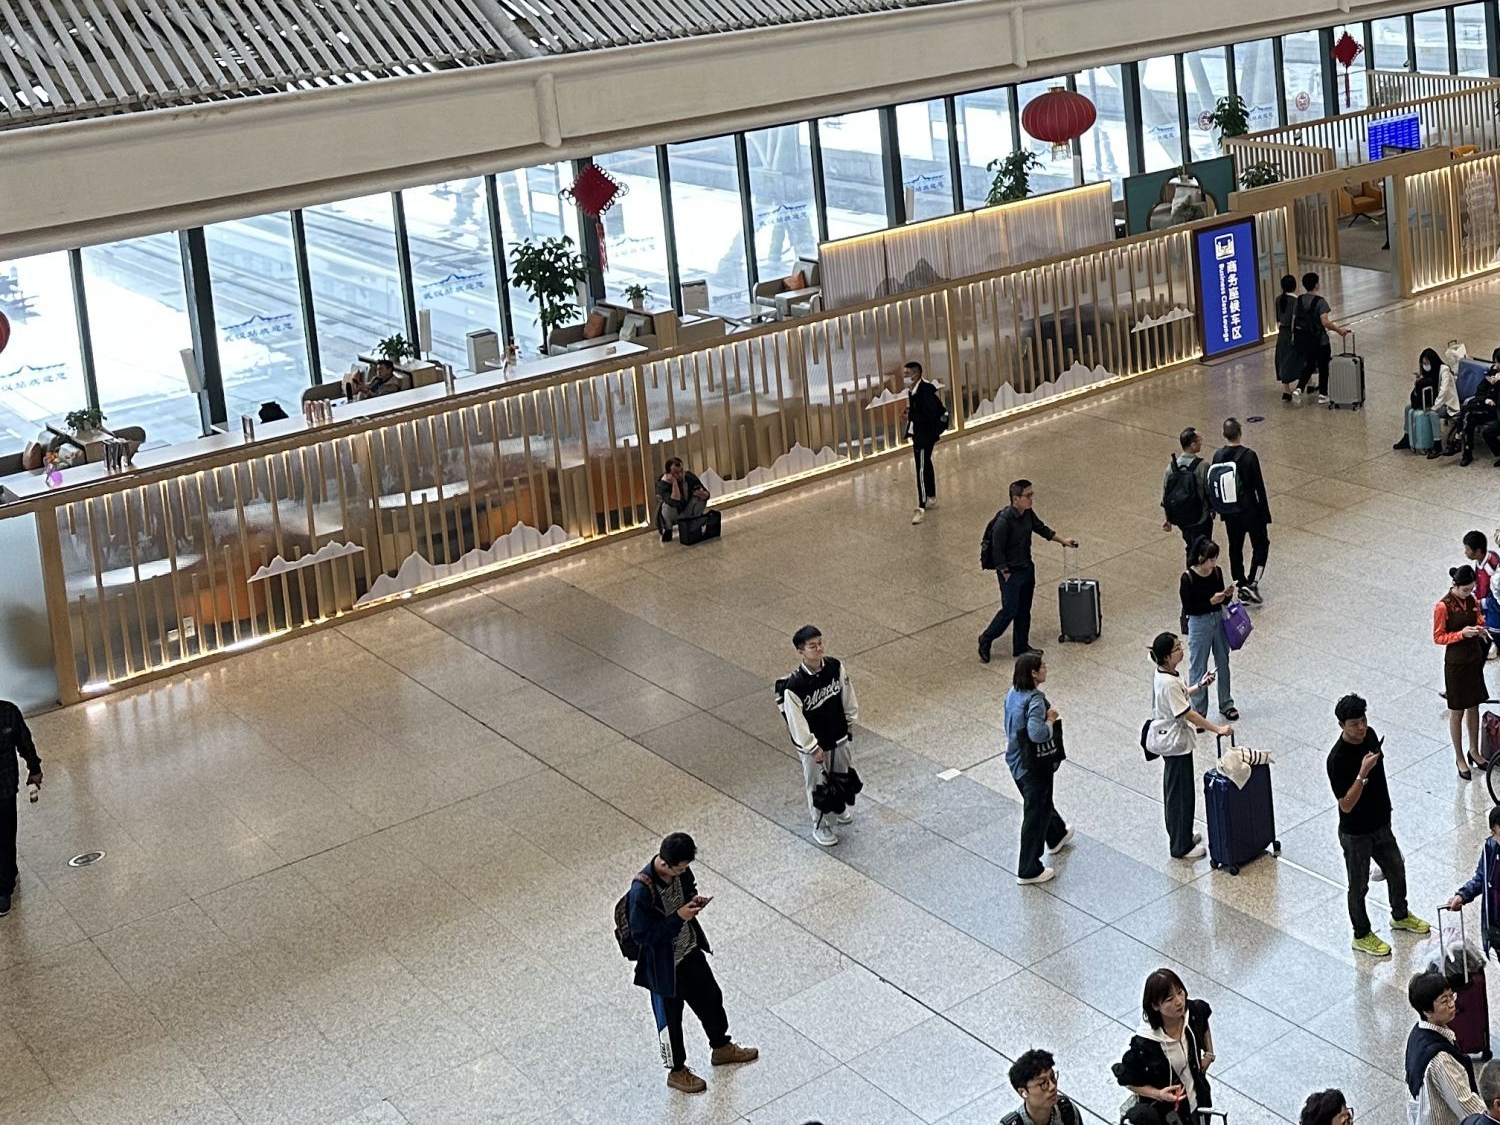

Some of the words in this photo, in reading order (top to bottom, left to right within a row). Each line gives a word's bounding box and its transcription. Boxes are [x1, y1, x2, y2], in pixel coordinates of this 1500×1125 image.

[1226, 260, 1242, 340] 商务座候车区
